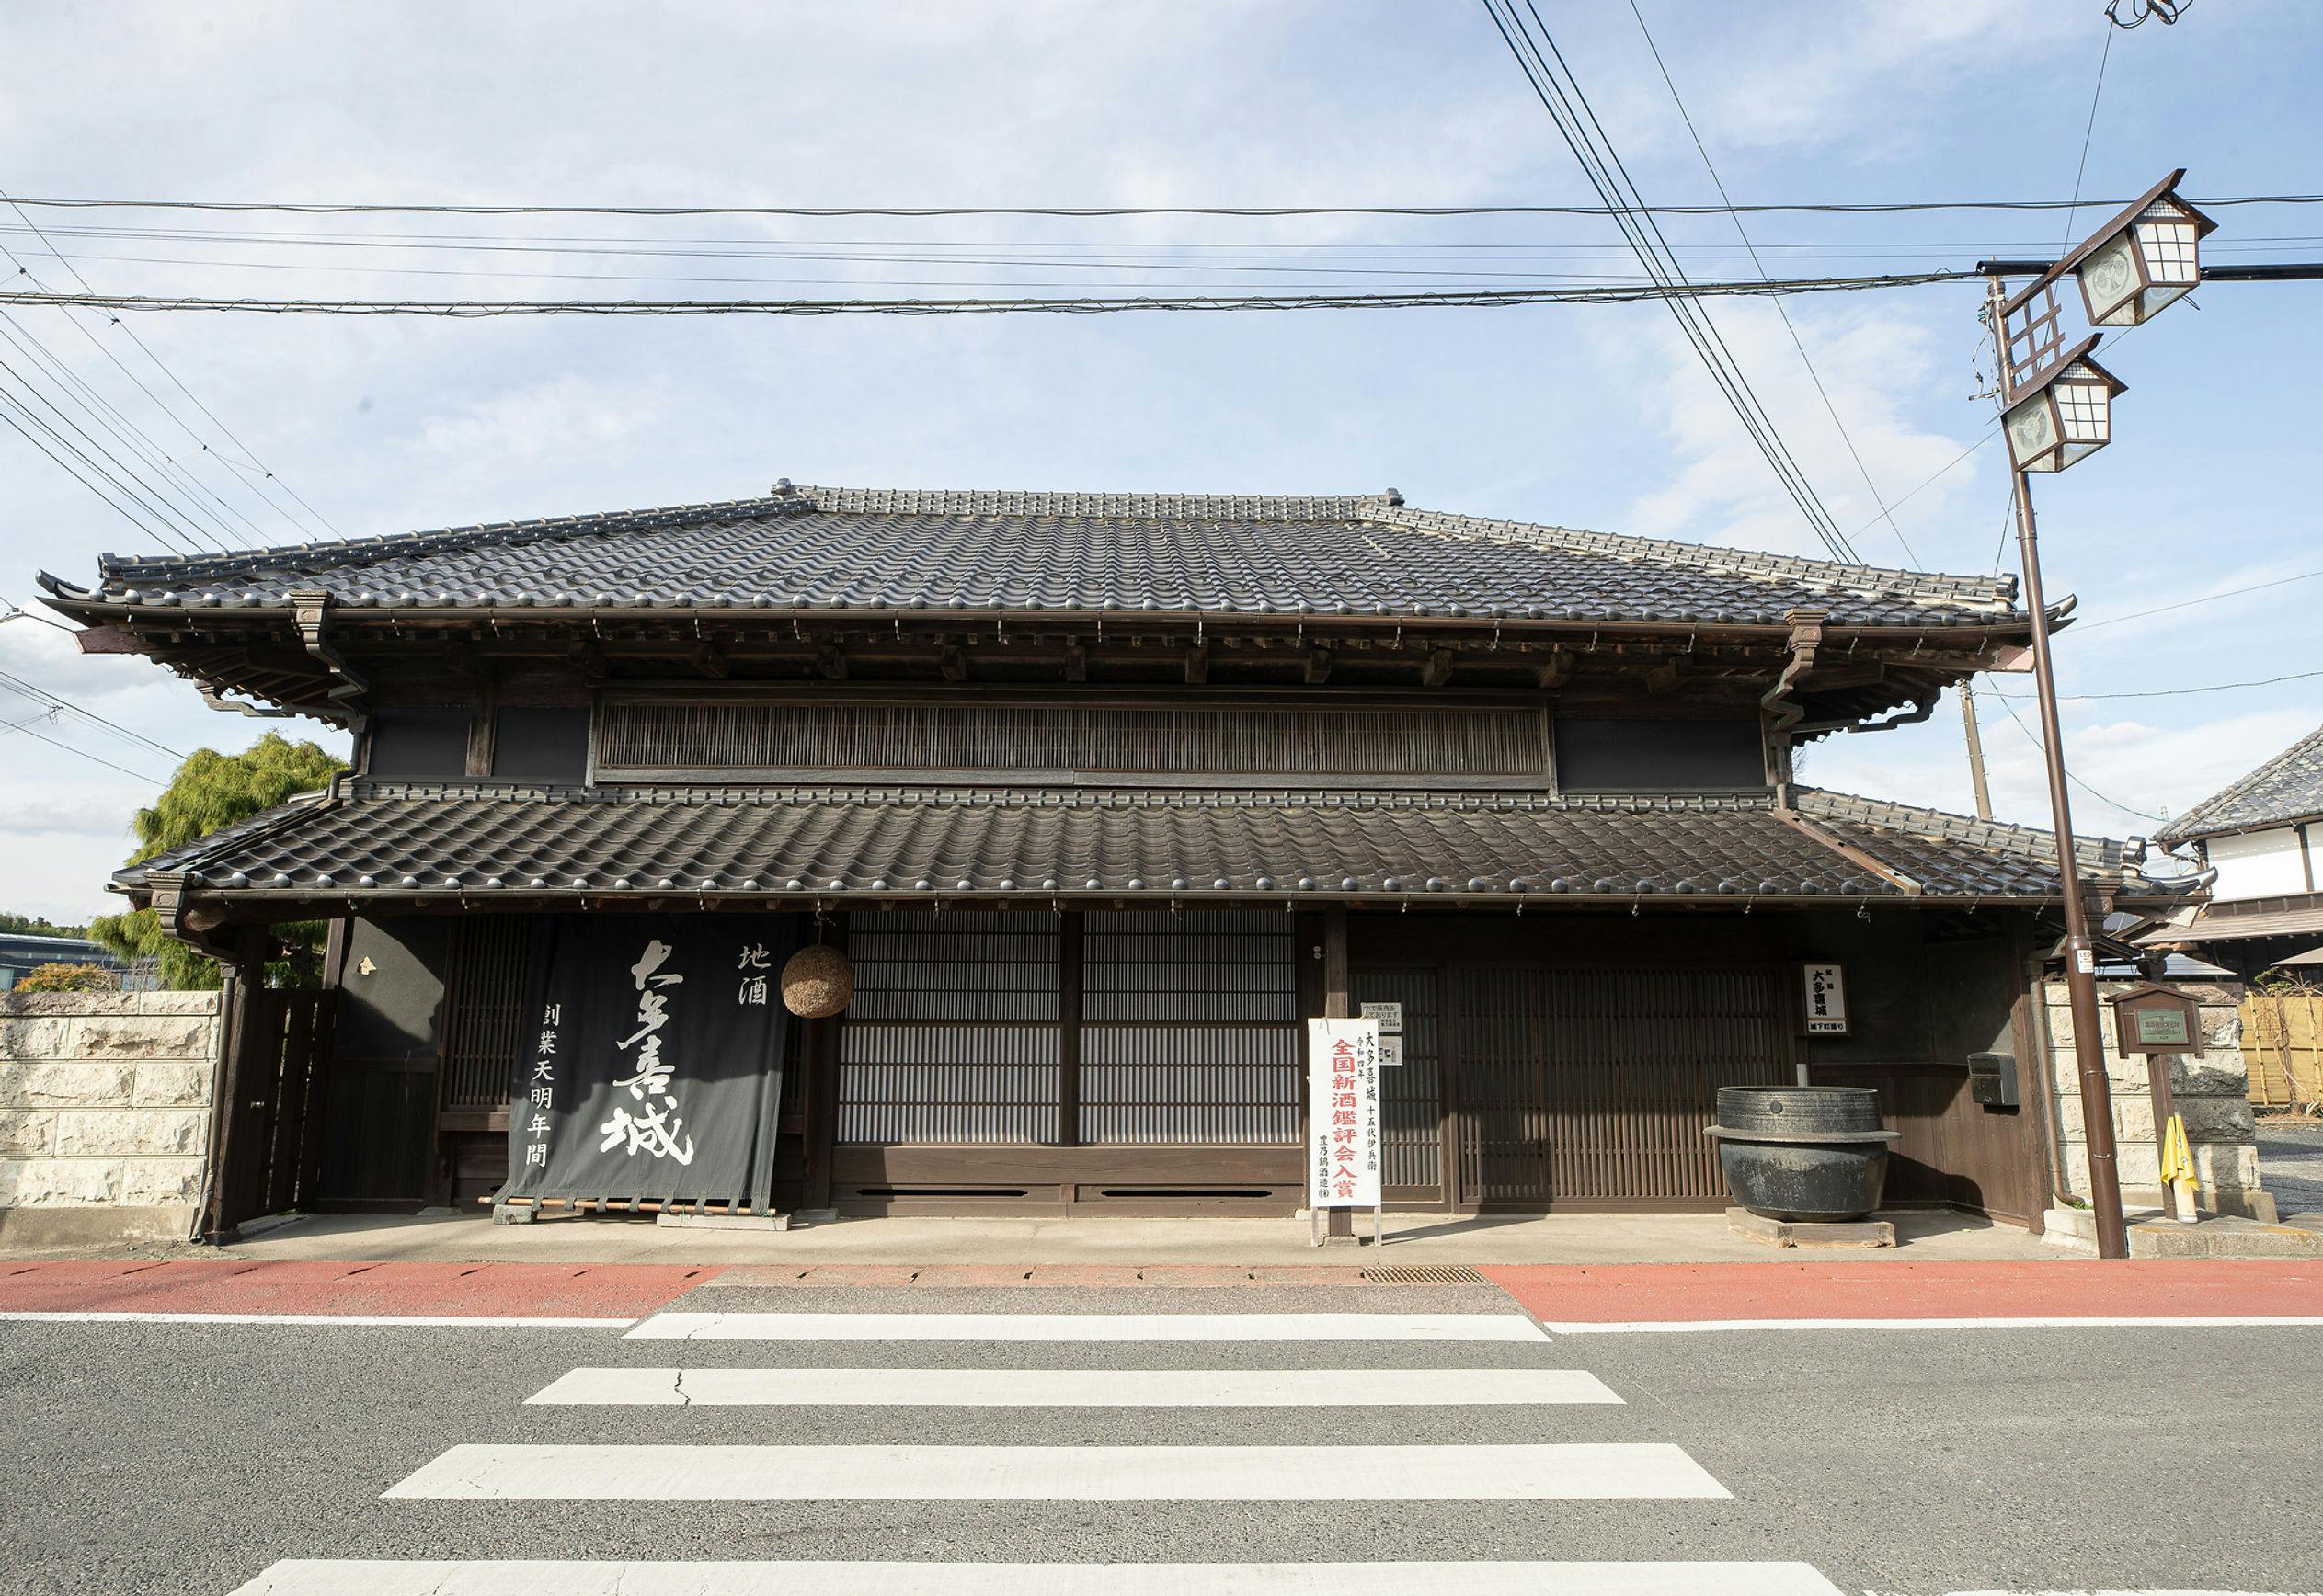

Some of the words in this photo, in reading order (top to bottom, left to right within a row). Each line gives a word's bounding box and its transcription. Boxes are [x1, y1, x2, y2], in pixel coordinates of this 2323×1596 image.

[738, 942, 772, 1005] 地酒
[525, 1003, 560, 1168] 創業天明年間
[600, 940, 694, 1166] 大多喜城
[1356, 1036, 1365, 1080] 令和四年
[1365, 1032, 1377, 1102] 大多喜城
[1332, 1039, 1358, 1199] 全国新酒鑑評会入賞
